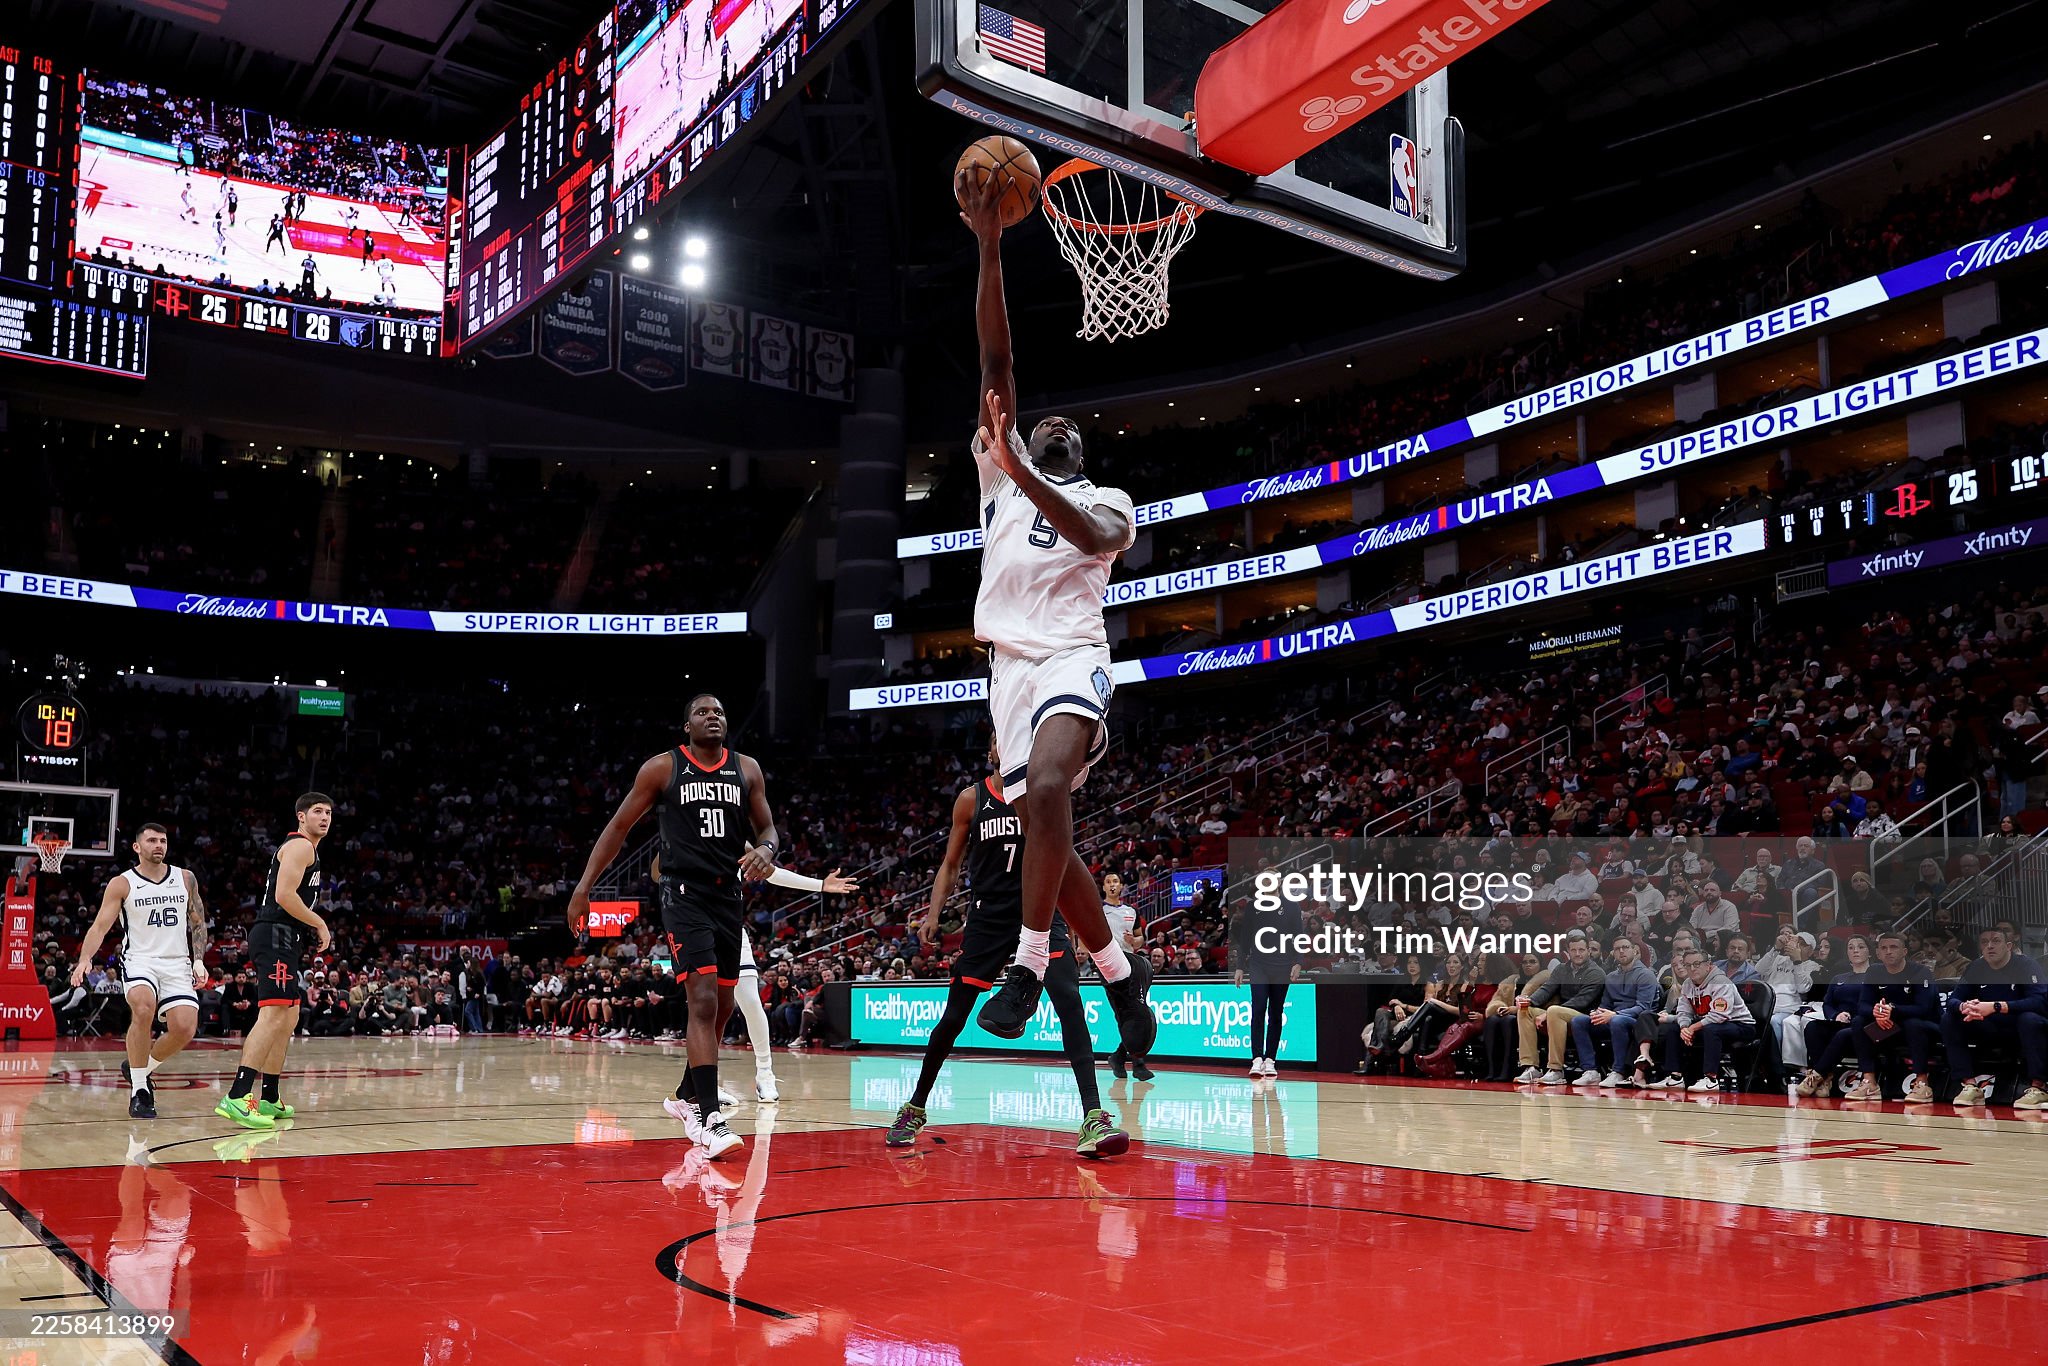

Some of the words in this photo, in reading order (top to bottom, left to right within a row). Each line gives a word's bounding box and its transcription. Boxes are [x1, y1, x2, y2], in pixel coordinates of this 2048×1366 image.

[789, 34, 798, 57] CC
[34, 56, 52, 74] FLS
[791, 56, 795, 75] 1
[6, 65, 15, 81] 0
[39, 75, 48, 91] 0
[6, 84, 12, 100] 1
[38, 94, 47, 110] 0
[4, 103, 12, 119] 0
[37, 113, 46, 129] 0
[722, 101, 735, 142] 26
[36, 132, 45, 148] 0
[691, 121, 714, 163] 10:14
[3, 141, 9, 157] 1
[37, 151, 42, 167] 1
[27, 169, 45, 187] FLS
[669, 151, 682, 189] 25
[951, 98, 981, 118] Vera
[982, 110, 1022, 134] Clinic
[1039, 132, 1139, 174] veraclinic.net
[1148, 173, 1179, 188] Hair
[1180, 184, 1251, 216] Transplant
[1251, 210, 1295, 231] Turkey
[1306, 229, 1388, 262] veraclinic.net
[33, 189, 41, 204] 2
[1395, 197, 1408, 213] NBA
[34, 208, 40, 223] 1
[32, 227, 38, 242] 1
[30, 245, 38, 262] 0
[28, 264, 37, 280] 0
[83, 266, 102, 285] TOL
[108, 272, 127, 289] FLS
[133, 277, 148, 294] CC
[137, 293, 142, 308] 1
[201, 294, 226, 324] 25
[558, 304, 594, 321] WNBA
[245, 302, 288, 328] 10:14
[306, 313, 330, 341] 26
[544, 314, 606, 337] Champions
[640, 308, 668, 323] 2000
[1503, 363, 1635, 425] SUPERIOR
[1646, 328, 1732, 377] LIGHT
[1746, 295, 1830, 345] BEER
[1946, 225, 2048, 280] Miche
[379, 320, 396, 337] TOL
[400, 324, 417, 339] FLS
[423, 327, 436, 342] CC
[637, 320, 671, 337] WNBA
[427, 341, 432, 355] 1
[624, 331, 683, 353] Champions
[1639, 407, 1799, 471] SUPERIOR
[1814, 369, 1919, 421] LIGHT
[1936, 335, 2041, 387] BEER
[1135, 501, 1174, 525] EER
[1241, 467, 1323, 505] Michelob
[1348, 433, 1431, 479] ULTRA
[1949, 470, 1978, 505] 25
[2011, 454, 2048, 484] 10:1
[1780, 515, 1795, 527] TOL
[1809, 507, 1824, 521] FLS
[1840, 500, 1852, 513] CC
[1813, 519, 1821, 536] 0
[1844, 512, 1850, 529] 1
[1028, 508, 1059, 549] 5
[1155, 566, 1218, 594] LIGHT
[1227, 554, 1286, 582] BEER
[1353, 514, 1430, 556] Michelob
[1457, 478, 1553, 525] ULTRA
[931, 531, 983, 552] SUPE
[1862, 549, 1925, 577] xfinity
[1963, 526, 2033, 556] xfinity
[22, 575, 93, 599] BEER
[177, 594, 266, 619] Michelob
[295, 603, 390, 627] ULTRA
[465, 614, 580, 631] SUPERIOR
[589, 617, 655, 632] LIGHT
[663, 616, 719, 632] BEER
[1177, 645, 1255, 676] Michelob
[1279, 621, 1355, 657] ULTRA
[1425, 576, 1548, 622] SUPERIOR
[1560, 552, 1640, 591] LIGHT
[1653, 532, 1732, 571] BEER
[1529, 635, 1574, 652] MEMORIAL
[1575, 625, 1622, 643] HERMANN
[300, 697, 341, 708] healthypaws
[877, 681, 981, 705] SUPERIOR
[46, 720, 72, 747] 18
[39, 755, 79, 766] TISSOT
[680, 782, 741, 806] HOUSTON
[700, 808, 724, 838] 30
[980, 816, 1021, 841] HOUST
[1004, 844, 1017, 873] 7
[135, 895, 184, 907] MEMPHIS
[148, 908, 178, 927] 46
[602, 913, 631, 926] PNC
[0, 1003, 44, 1021] finity
[866, 993, 948, 1025] healthypaw
[905, 1027, 925, 1038] Chubb
[1203, 1036, 1209, 1047] a
[1211, 1035, 1240, 1048] Chubb
